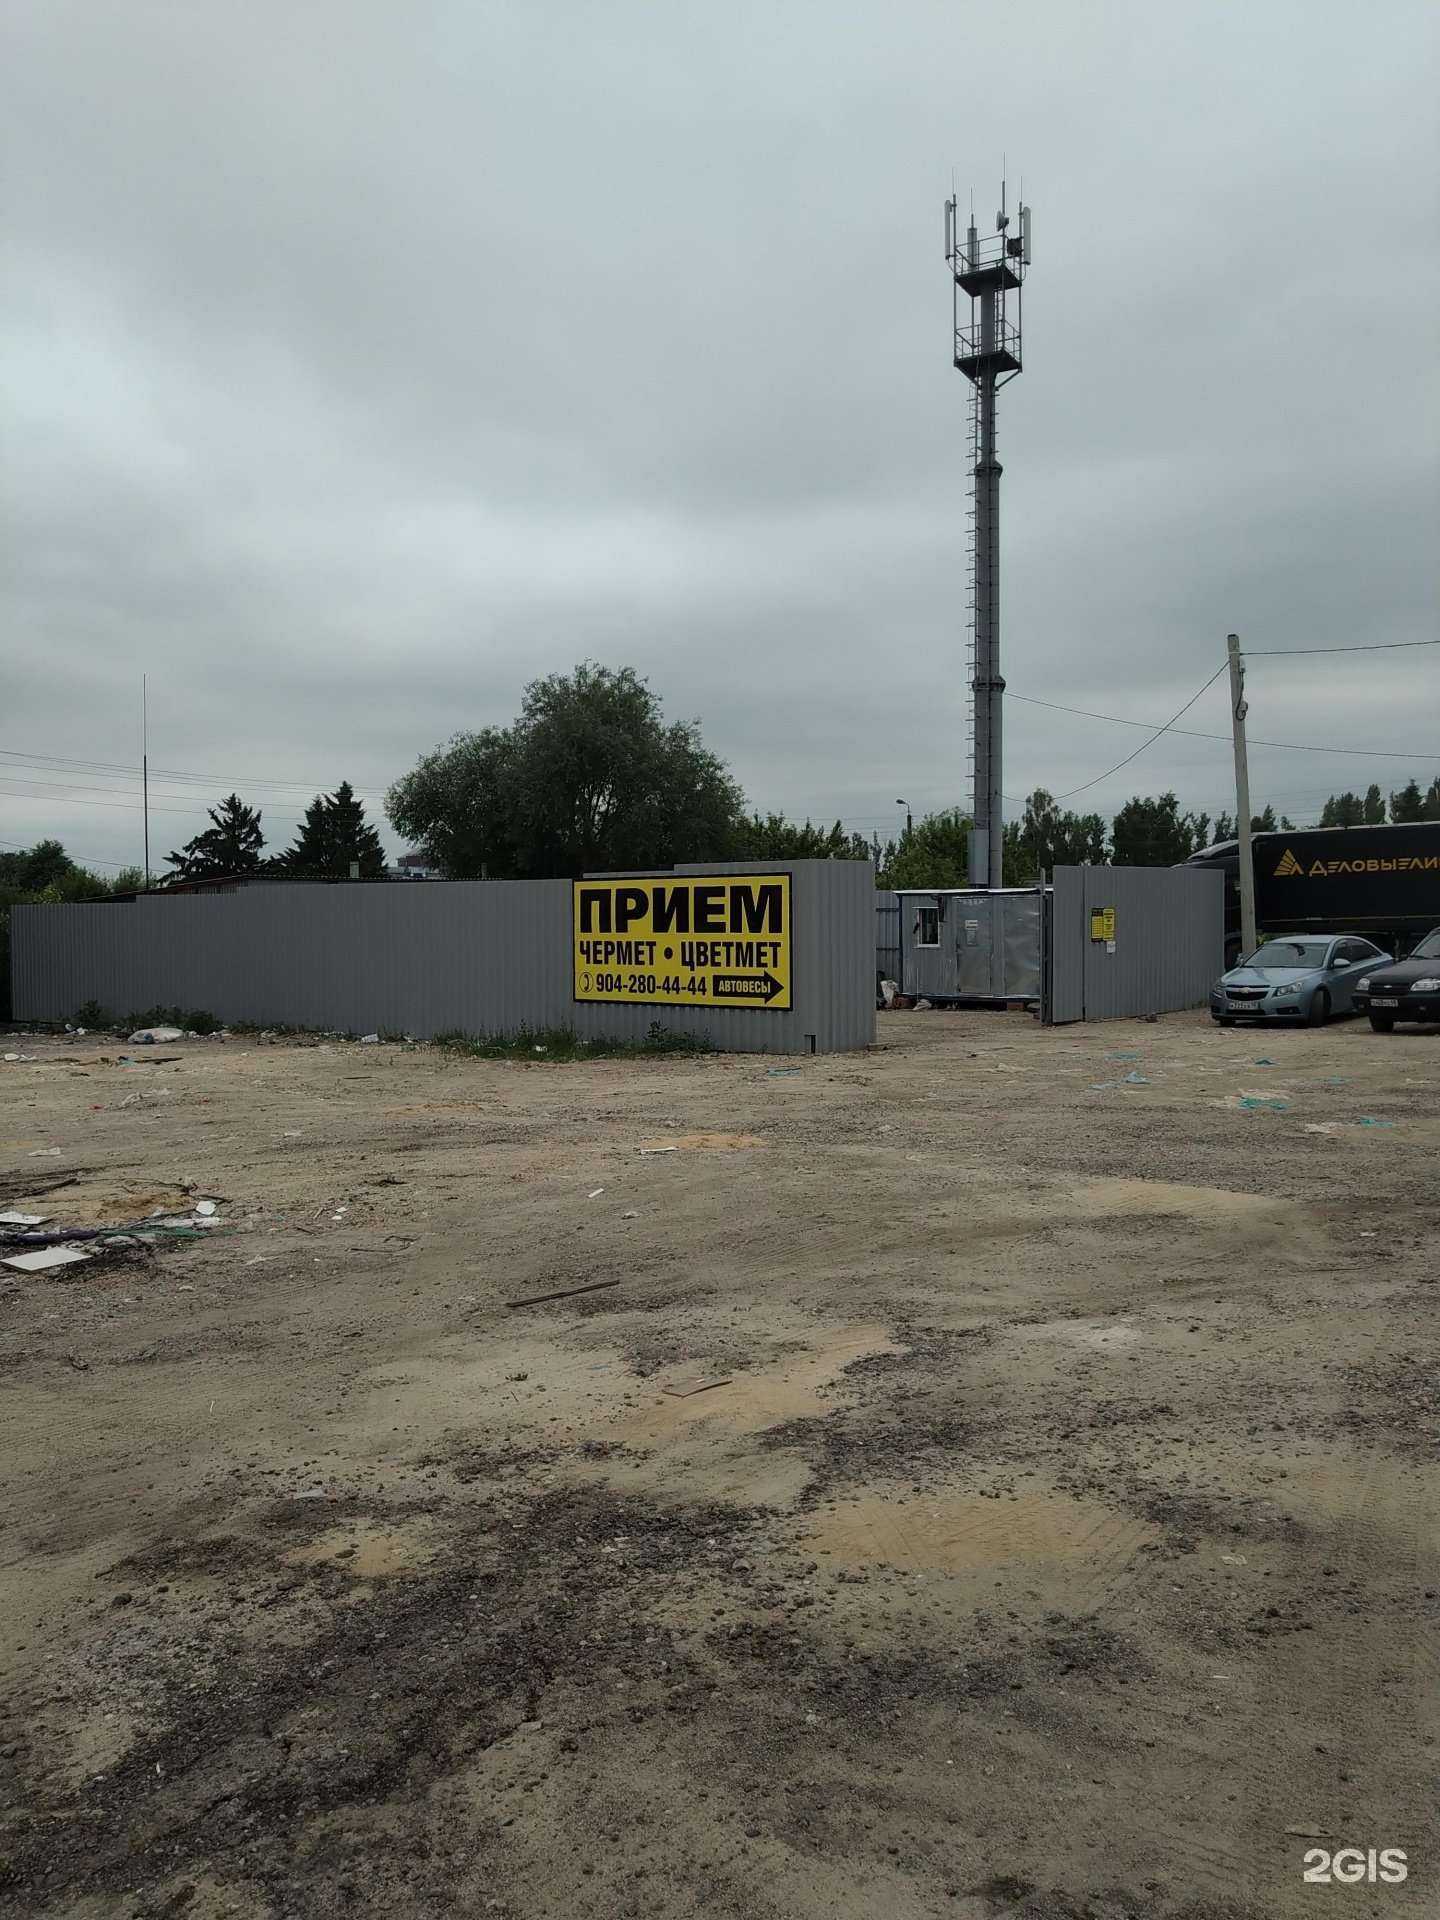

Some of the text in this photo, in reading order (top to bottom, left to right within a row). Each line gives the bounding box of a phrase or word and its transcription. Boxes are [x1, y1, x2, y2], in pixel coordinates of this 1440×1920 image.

[1309, 856, 1440, 877] ДЕЛОВЫЕЛИ
[580, 884, 783, 934] ПРИЕМ
[579, 940, 782, 971] ЧЕРМЕТ ЦВЕТМЕТ
[596, 973, 707, 996] 904-280-44-44
[718, 979, 771, 994] АВТОВЕСЫ
